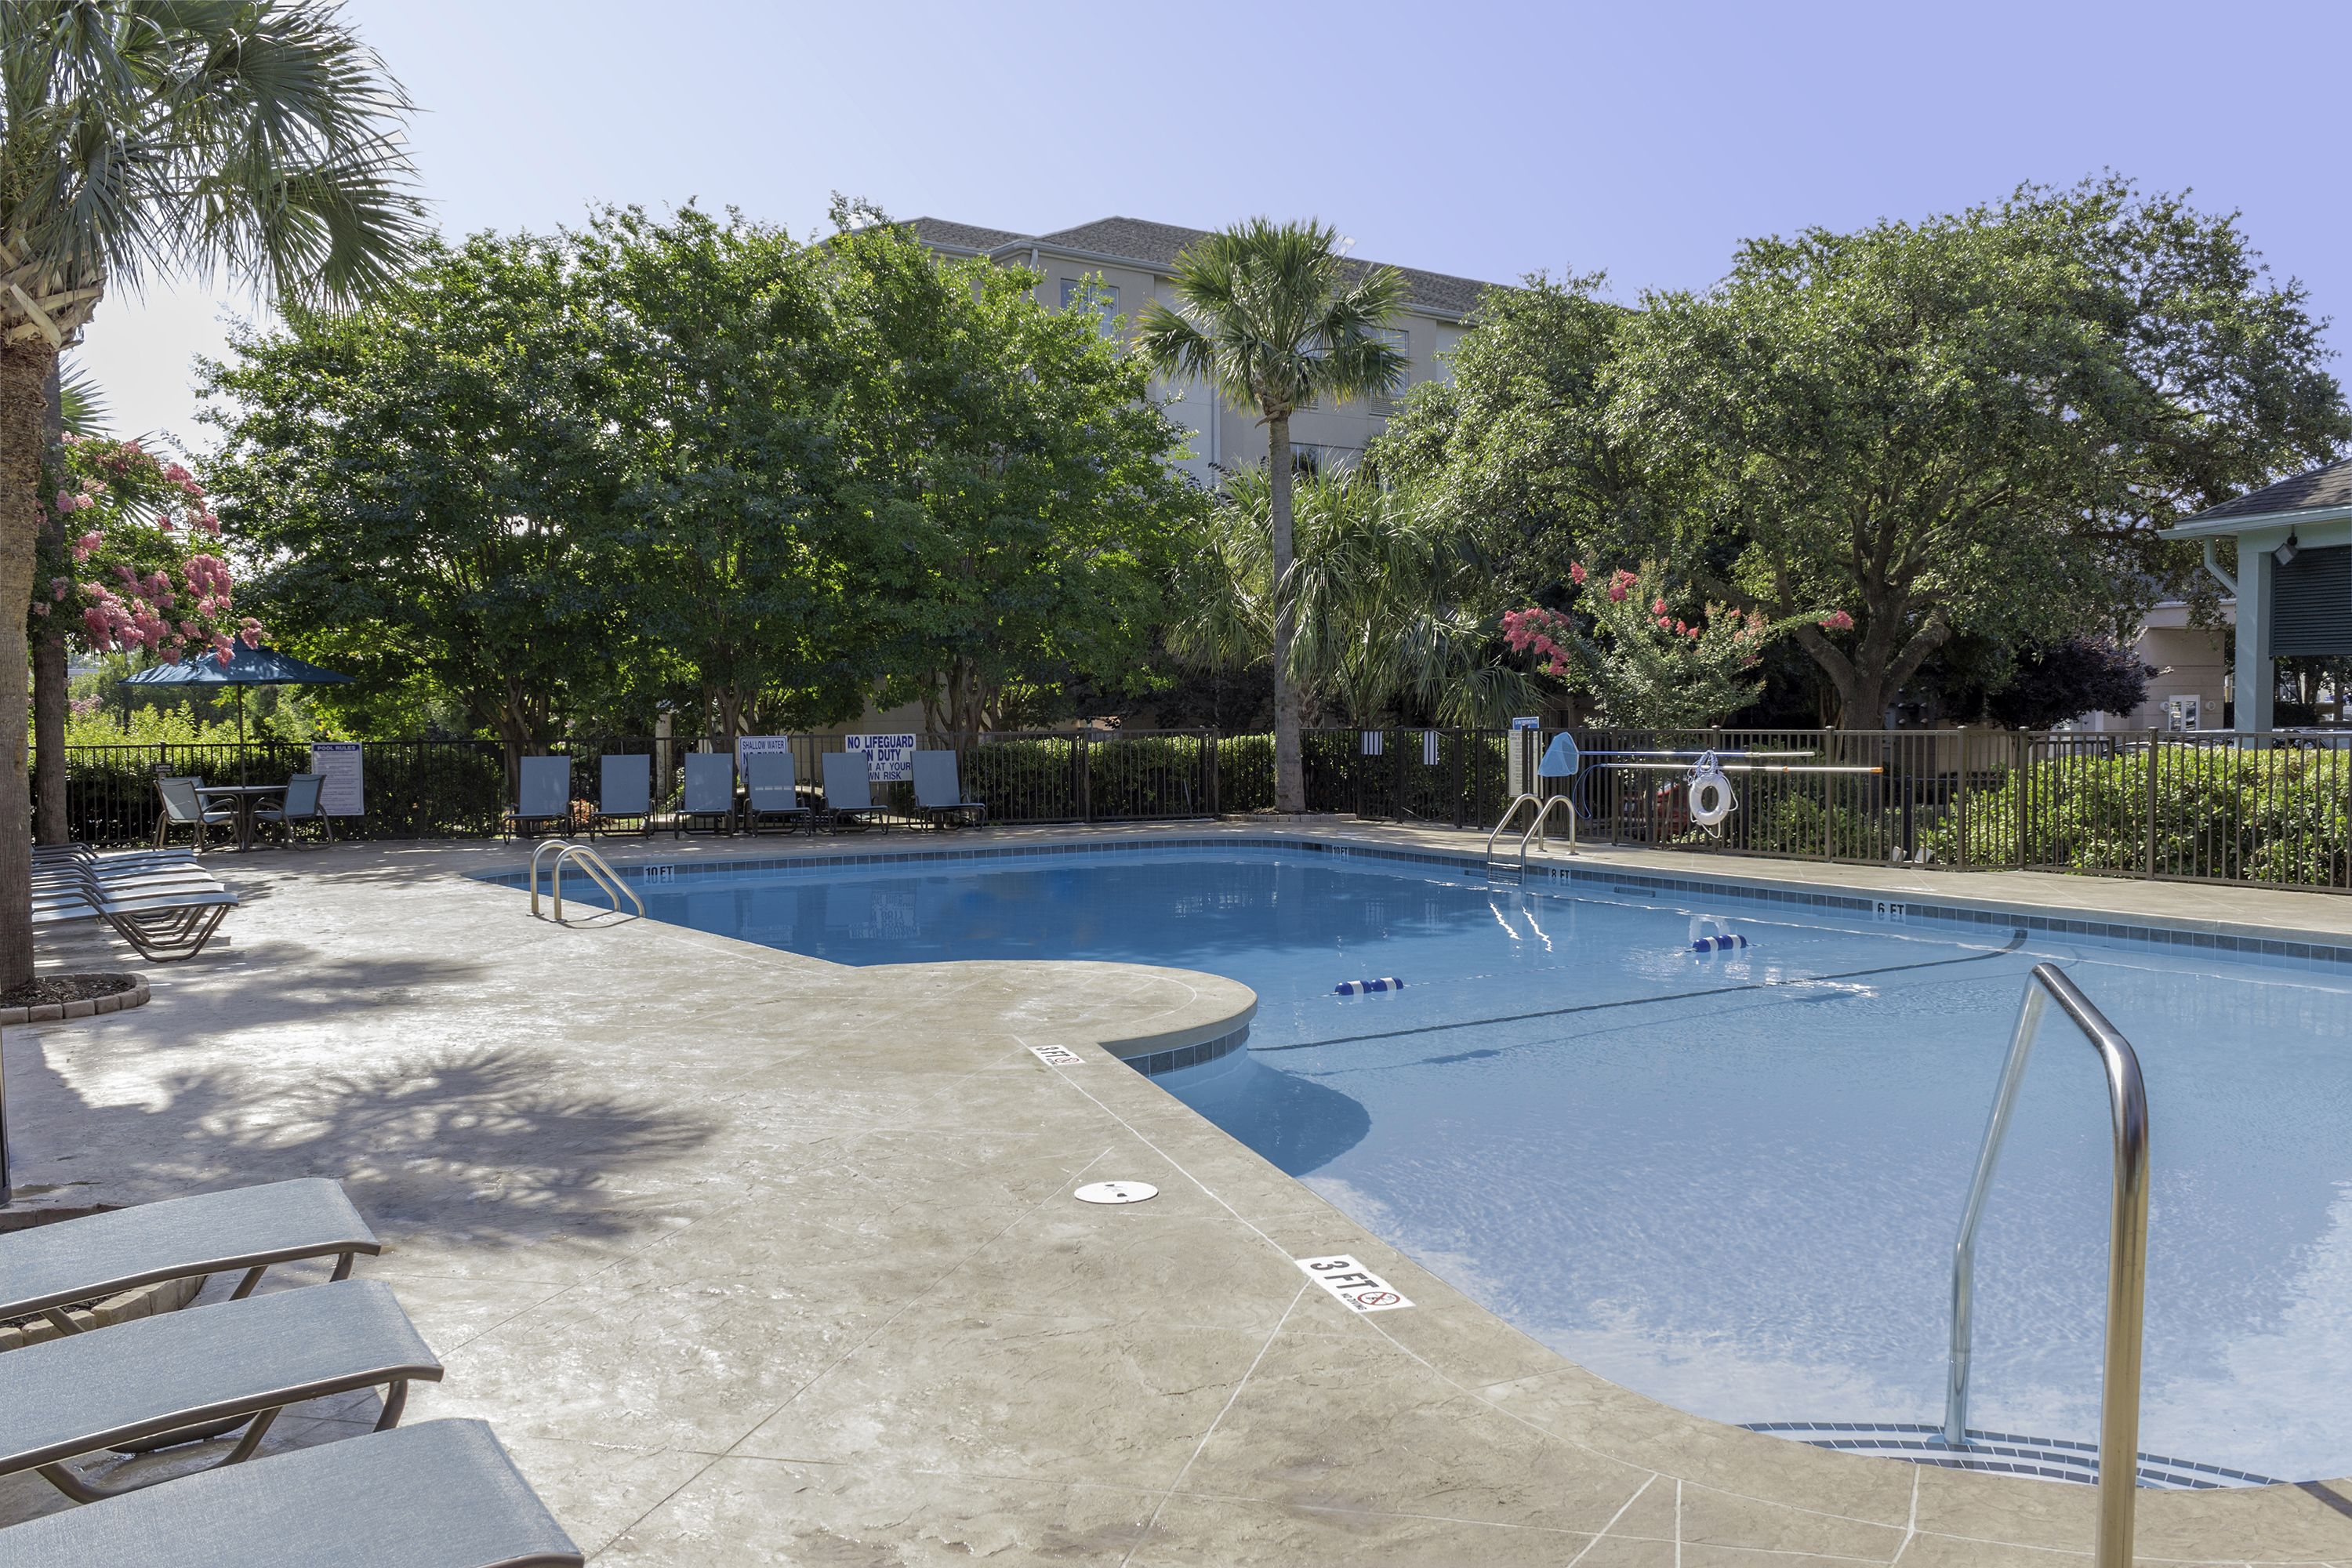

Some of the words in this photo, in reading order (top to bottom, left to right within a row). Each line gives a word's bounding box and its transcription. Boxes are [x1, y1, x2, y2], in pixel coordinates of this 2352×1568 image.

[742, 741, 766, 750] SHALLOW
[768, 740, 784, 750] WATER
[848, 736, 861, 749] NO
[865, 735, 913, 749] LIFEGUARD
[878, 749, 901, 761] DUTY
[875, 762, 886, 771] AT
[889, 762, 911, 771] YOUR
[869, 771, 880, 780] WN
[884, 771, 902, 780] RISK
[646, 866, 658, 876] 10
[660, 866, 673, 875] FT
[1552, 869, 1556, 877] 8
[1560, 869, 1570, 878] FT
[1878, 902, 1885, 913] 6
[1890, 903, 1904, 915] FT
[1310, 1261, 1350, 1270] 3
[1324, 1272, 1380, 1289] FT
